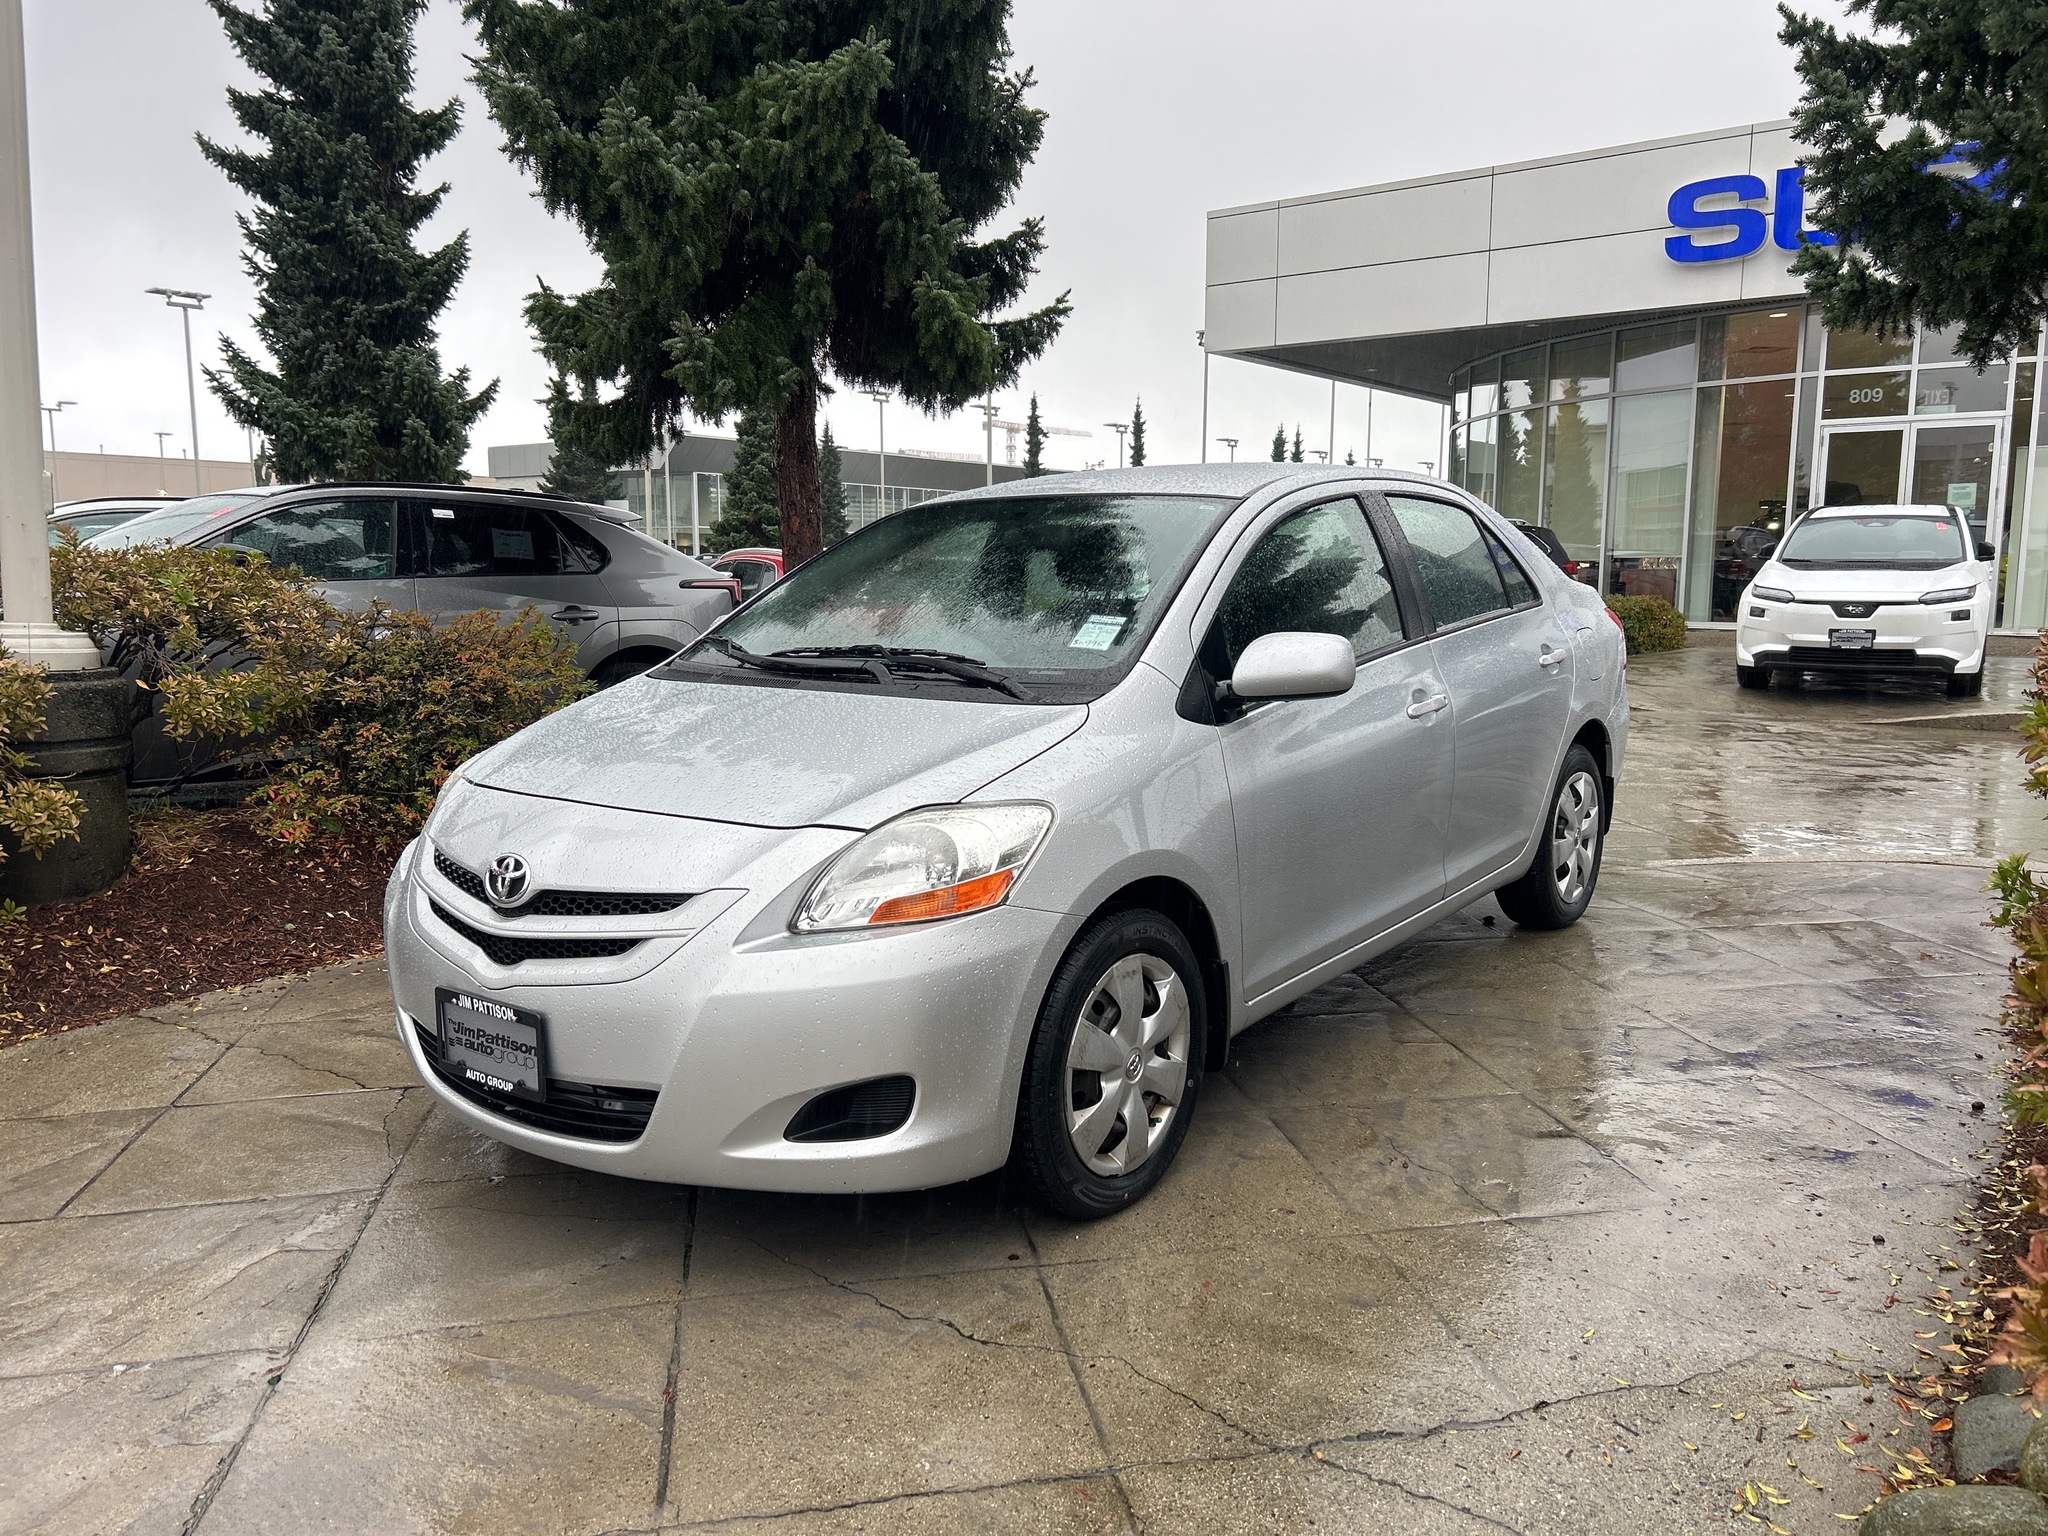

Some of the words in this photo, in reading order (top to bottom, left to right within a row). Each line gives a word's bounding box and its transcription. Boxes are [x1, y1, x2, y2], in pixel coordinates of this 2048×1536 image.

[1848, 387, 1884, 404] 809
[458, 994, 472, 1010] JIM
[473, 998, 514, 1021] PATTISON
[466, 1069, 486, 1083] AUTO
[487, 1076, 514, 1092] GROUP
